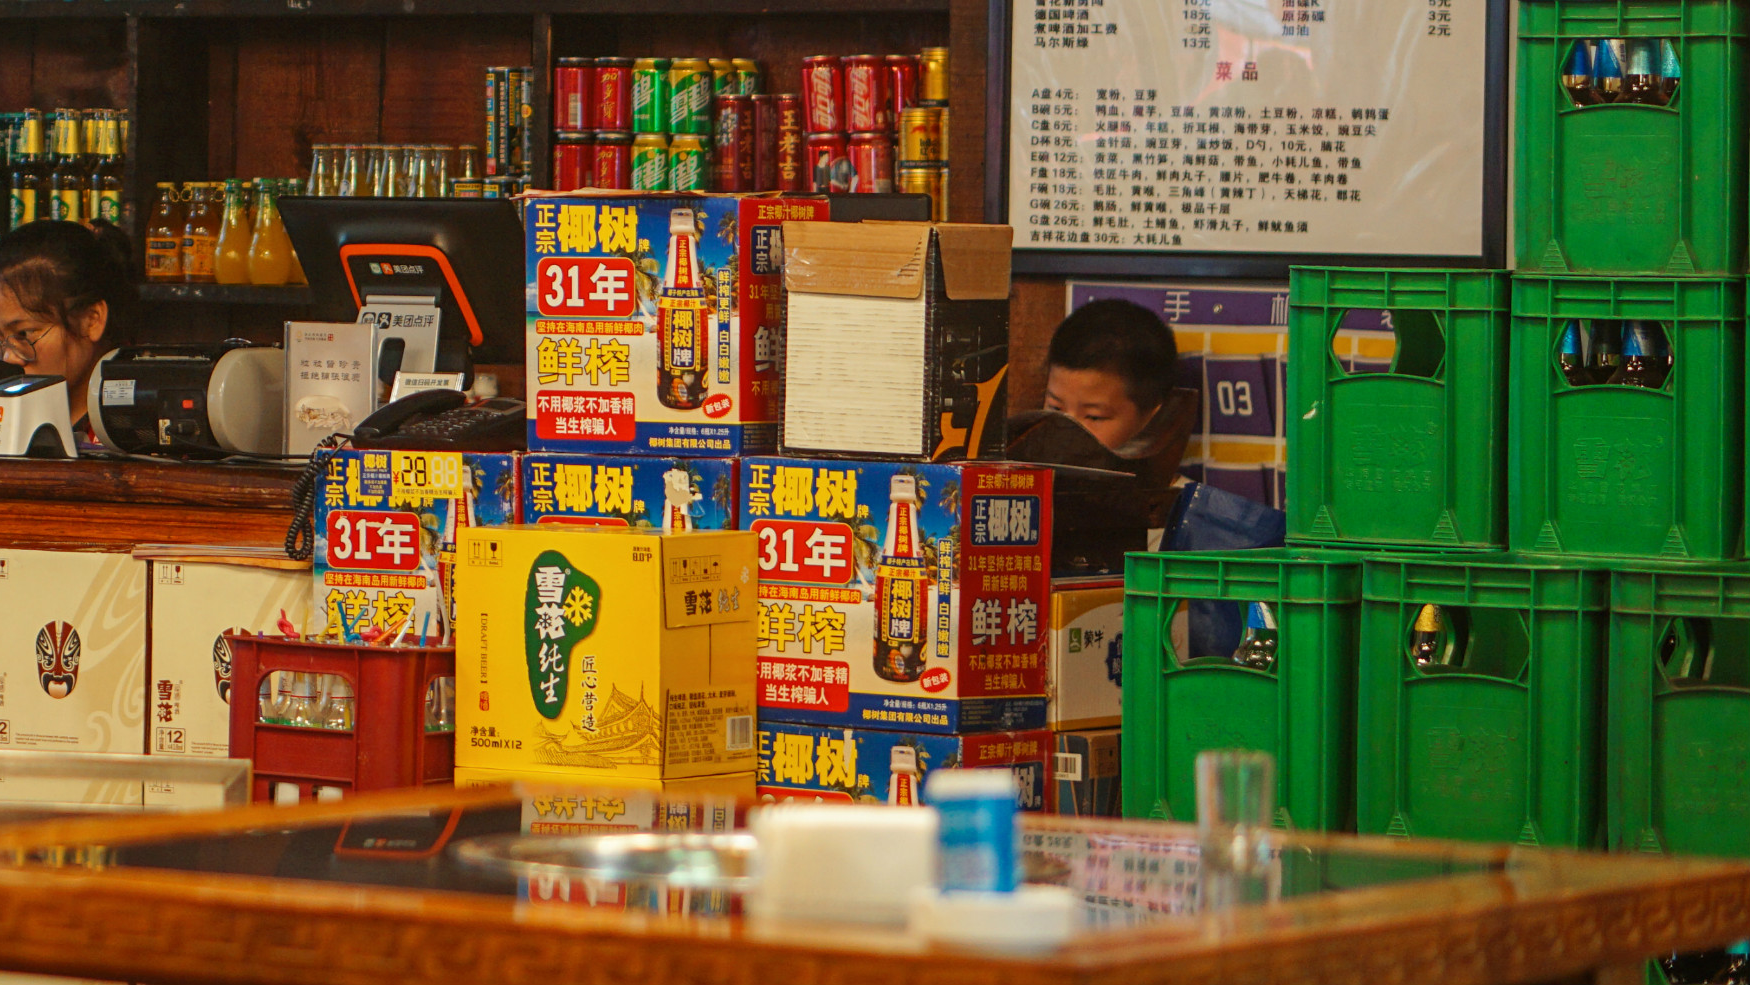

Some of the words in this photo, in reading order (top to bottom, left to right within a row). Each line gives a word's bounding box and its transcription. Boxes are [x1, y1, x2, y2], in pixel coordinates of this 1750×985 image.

[1034, 8, 1089, 21] 德国啤酒
[1182, 9, 1211, 21] 18元
[1216, 61, 1258, 82] 菜品
[778, 109, 800, 181] 王老吉
[535, 203, 556, 254] 正宗
[679, 239, 690, 285] 正宗椰树牌
[545, 262, 630, 312] 31年
[392, 314, 435, 328] 美团点评
[537, 320, 644, 335] 坚持在海南岛用新鲜椰肉
[537, 337, 631, 386] 鲜榨
[537, 395, 634, 415] 不用椰浆不加香精
[704, 398, 730, 415] 新包装
[1216, 380, 1253, 416] 03
[555, 416, 617, 436] 当生榨骗人
[648, 437, 731, 450] 椰树集团有限公司出品
[531, 462, 553, 513] 正宗
[748, 464, 771, 516] 正宗
[334, 516, 415, 565] 31年
[758, 527, 847, 578] 31年
[968, 554, 1042, 573] 31年坚持在海南岛
[325, 573, 427, 590] 坚持在海南岛用新鲜椰肉
[683, 588, 713, 616] 雪花
[534, 565, 566, 704] 雪花纯生
[971, 597, 1038, 647] 鲜榨
[581, 655, 599, 733] 匠心营造
[765, 684, 829, 706] 当生榨骗人
[984, 672, 1026, 691] 当生榨骗人
[156, 679, 173, 723] 雪花
[861, 708, 949, 726] 椰树集团有限公司出品
[166, 730, 184, 744] 12
